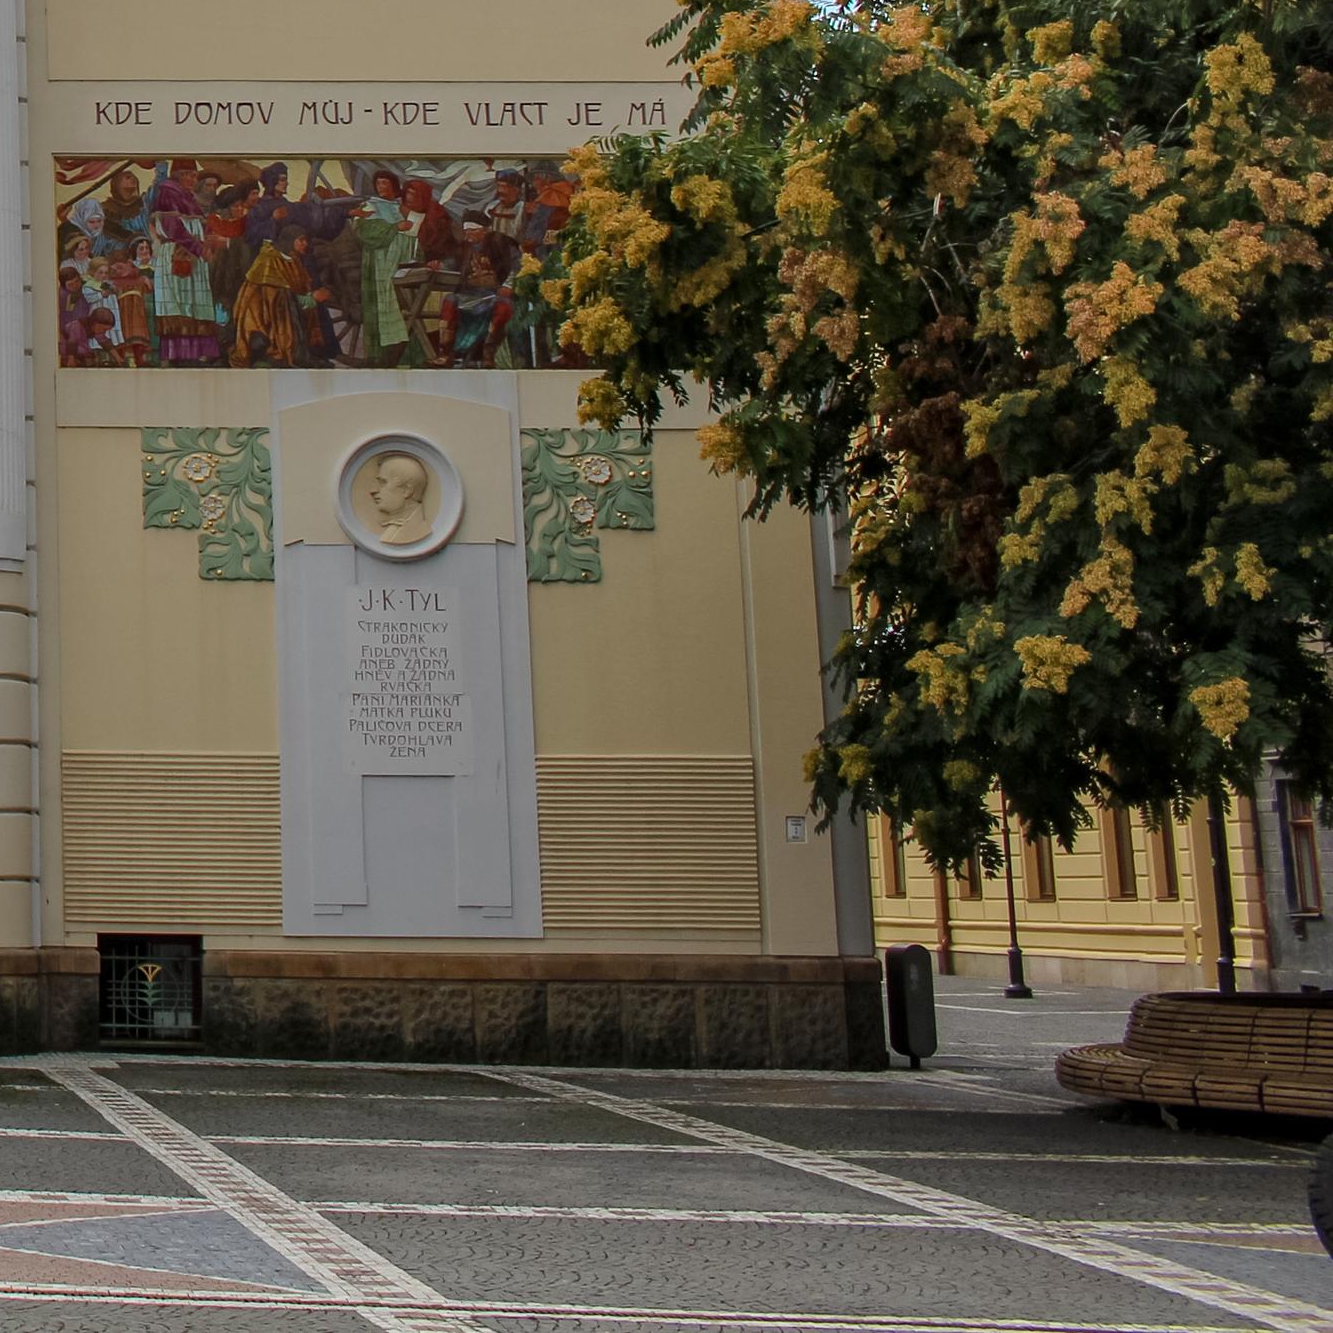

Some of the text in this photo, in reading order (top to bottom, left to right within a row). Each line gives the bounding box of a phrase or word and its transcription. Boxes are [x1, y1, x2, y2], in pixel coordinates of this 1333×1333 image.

[96, 102, 153, 125] KDE
[175, 102, 274, 126] DOMOV
[383, 102, 440, 126] KDE
[567, 102, 603, 126] JE
[628, 99, 667, 126] MÁ
[405, 590, 446, 611] TYL
[360, 659, 395, 669] ANEB
[398, 671, 406, 680] A
[360, 708, 452, 718] MATKA PLUKU
[418, 722, 462, 732] DCERA
